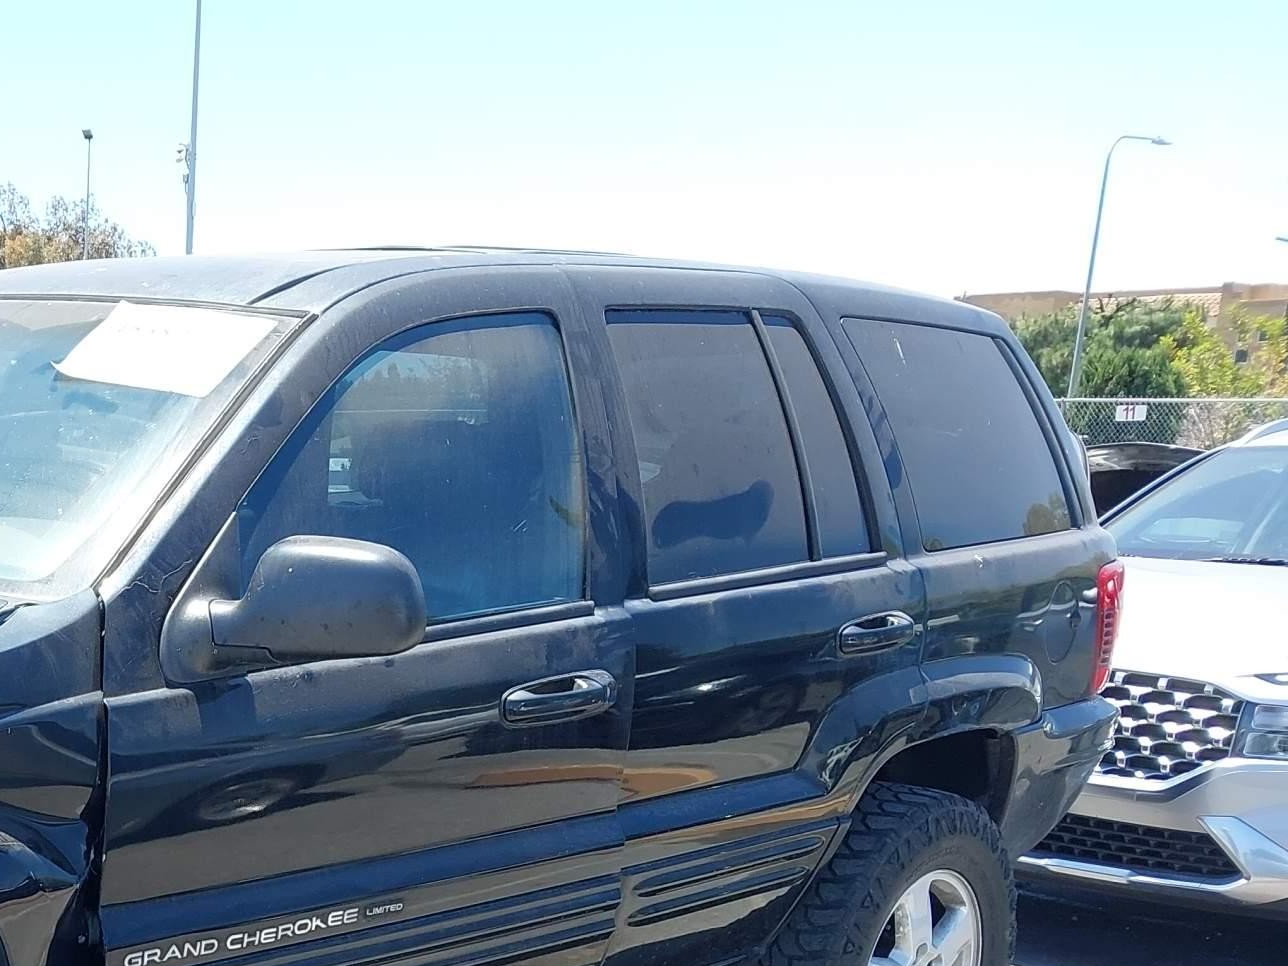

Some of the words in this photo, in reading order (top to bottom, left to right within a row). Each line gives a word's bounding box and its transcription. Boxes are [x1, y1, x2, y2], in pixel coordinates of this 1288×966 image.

[1123, 405, 1136, 419] 11
[366, 903, 403, 916] LIMITED
[226, 908, 359, 950] CHEROKEE
